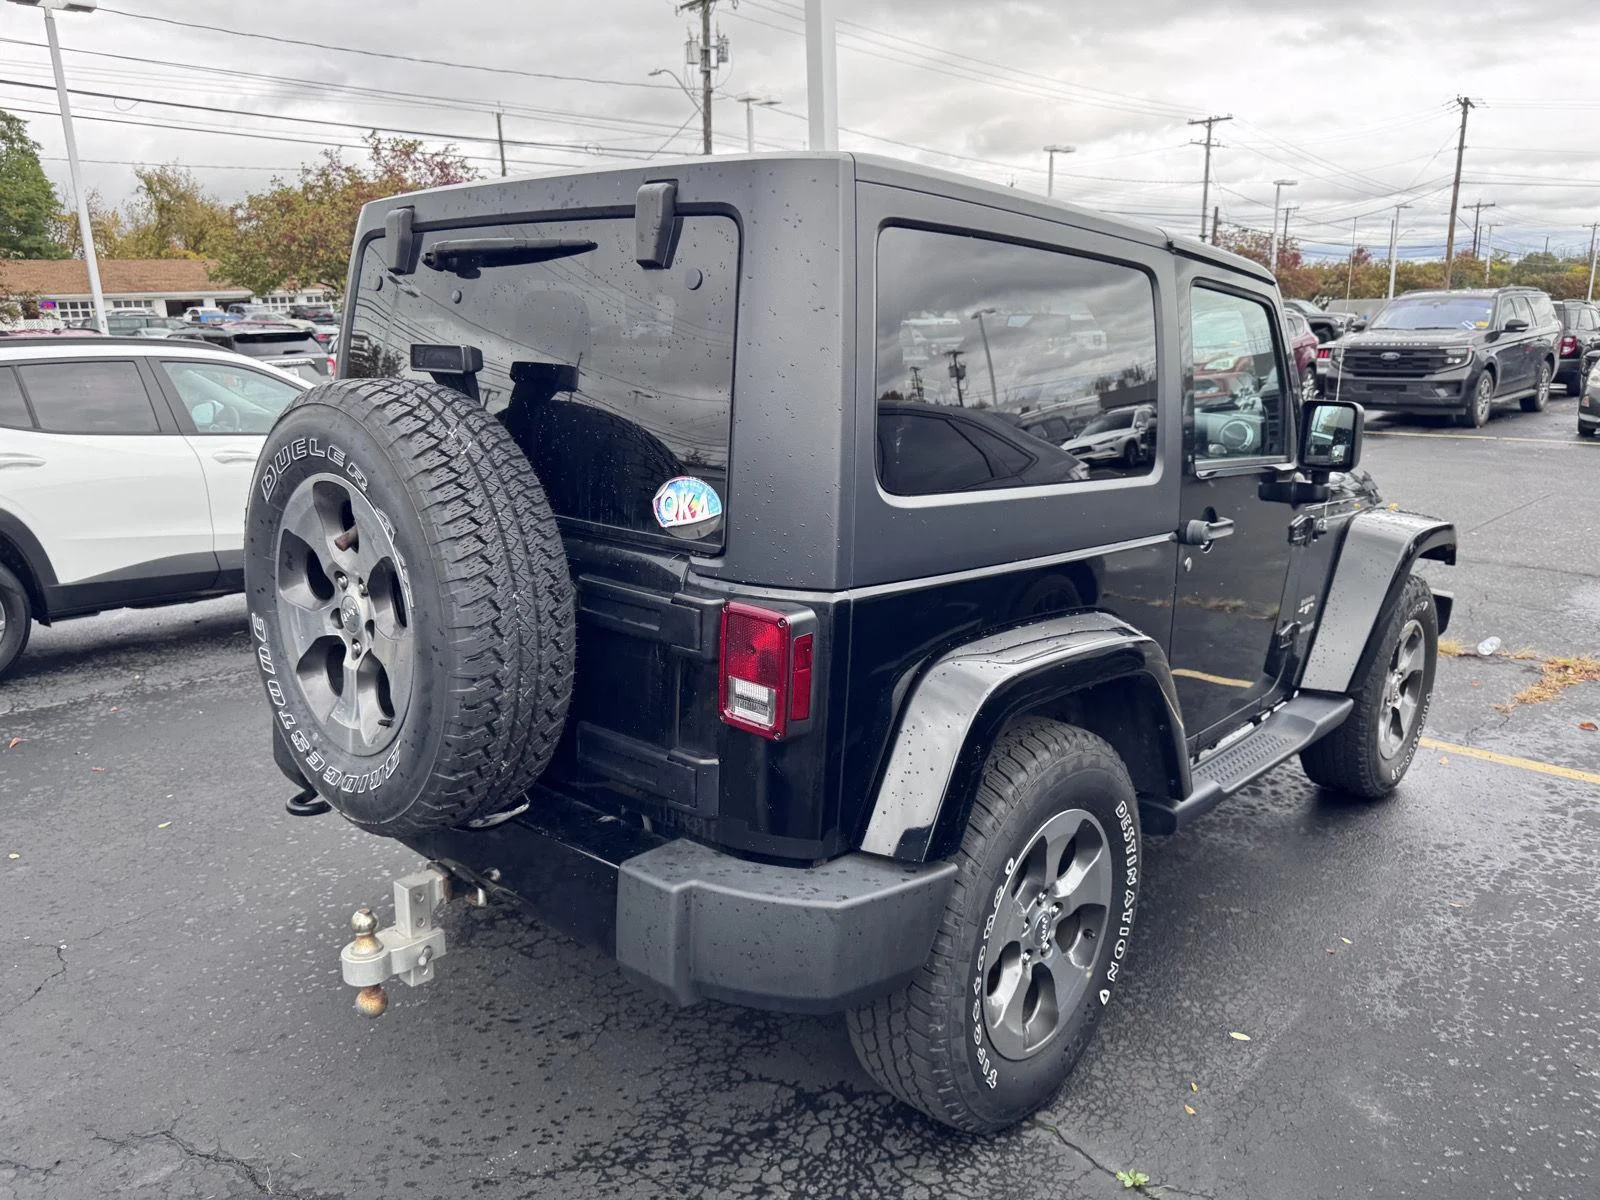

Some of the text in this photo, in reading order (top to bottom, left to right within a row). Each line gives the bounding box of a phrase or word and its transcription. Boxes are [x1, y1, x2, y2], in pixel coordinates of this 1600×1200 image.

[261, 438, 369, 502] DUELER
[252, 612, 400, 793] BRIDGESTONE
[1107, 800, 1137, 982] DESTINATION
